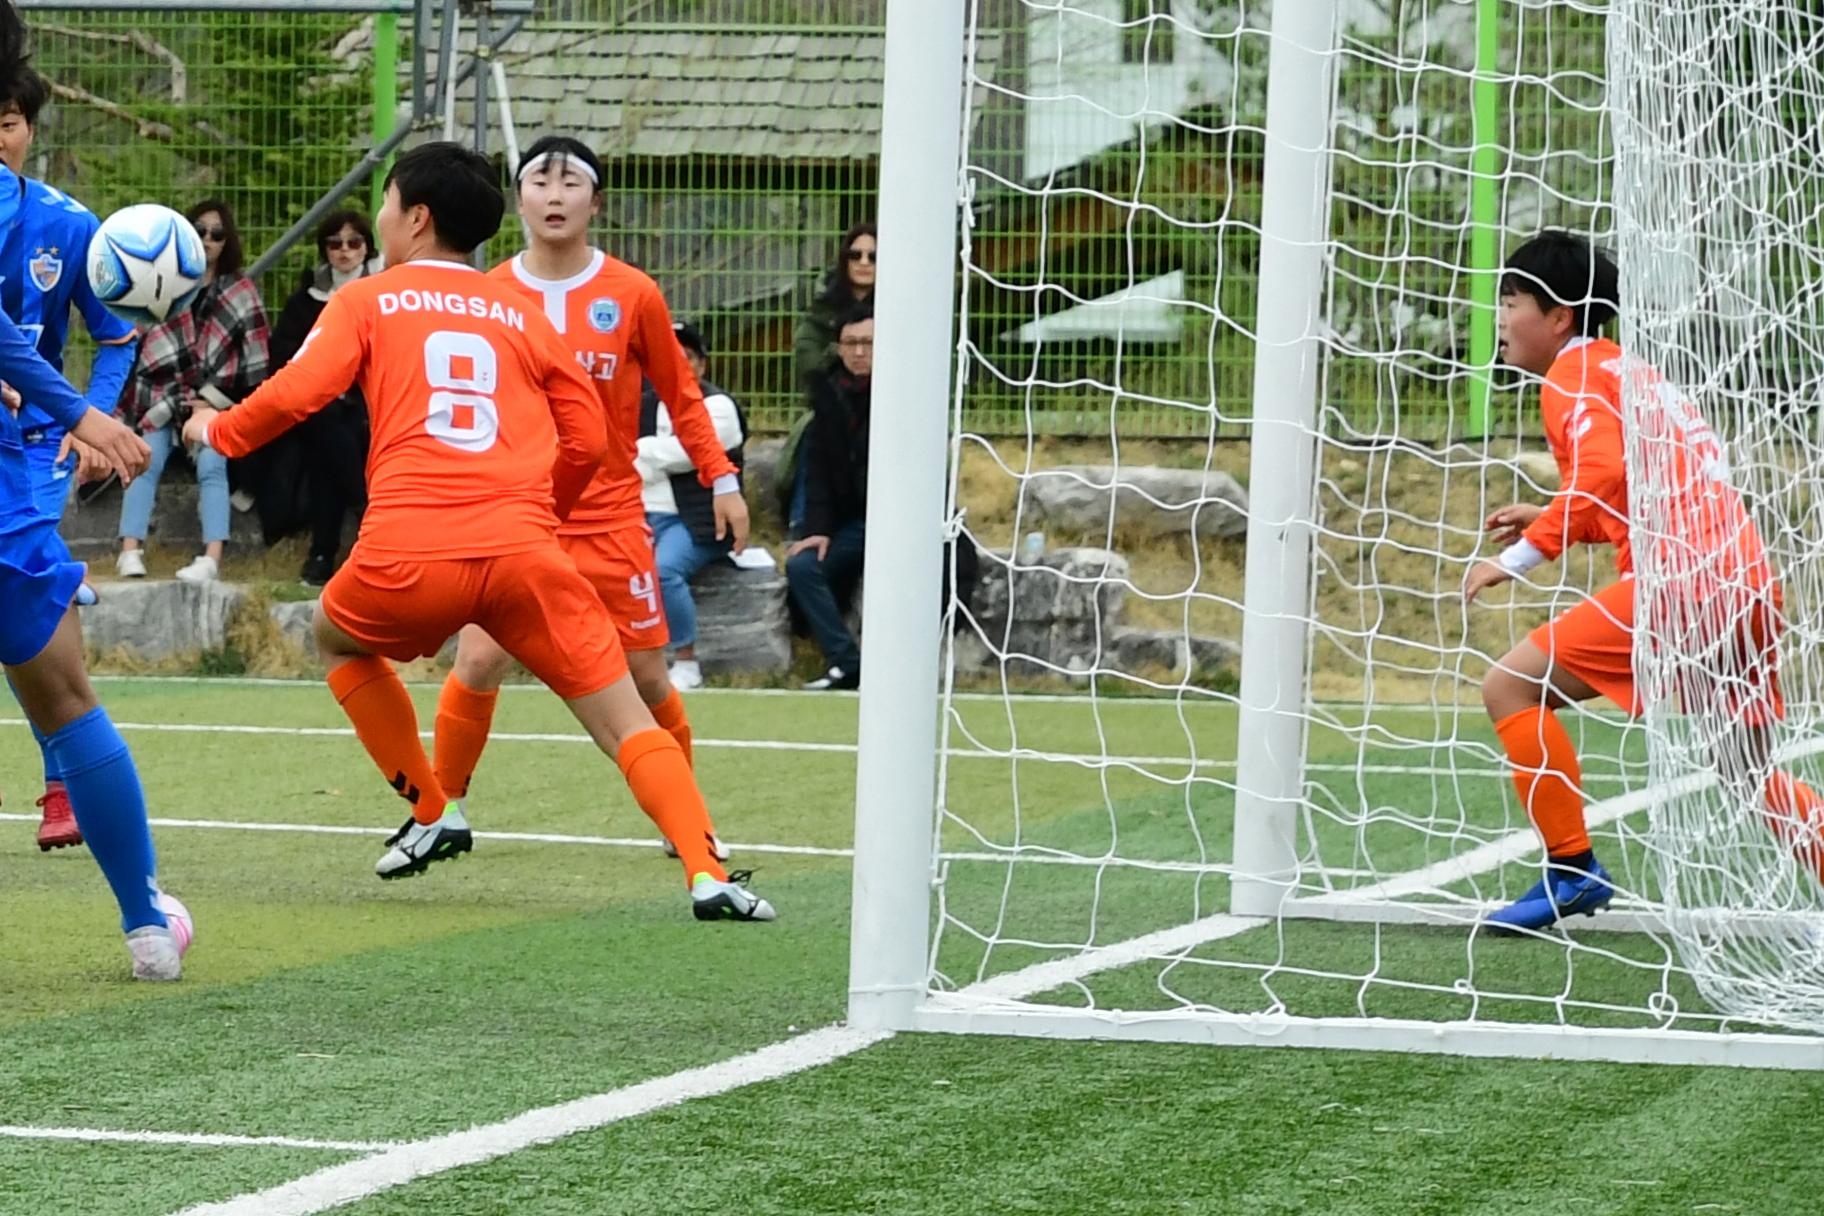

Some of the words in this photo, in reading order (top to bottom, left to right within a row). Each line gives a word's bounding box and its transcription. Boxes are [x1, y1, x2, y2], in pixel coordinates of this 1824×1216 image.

[378, 289, 524, 332] DONGSAN
[424, 330, 499, 452] 8
[629, 571, 656, 613] 4
